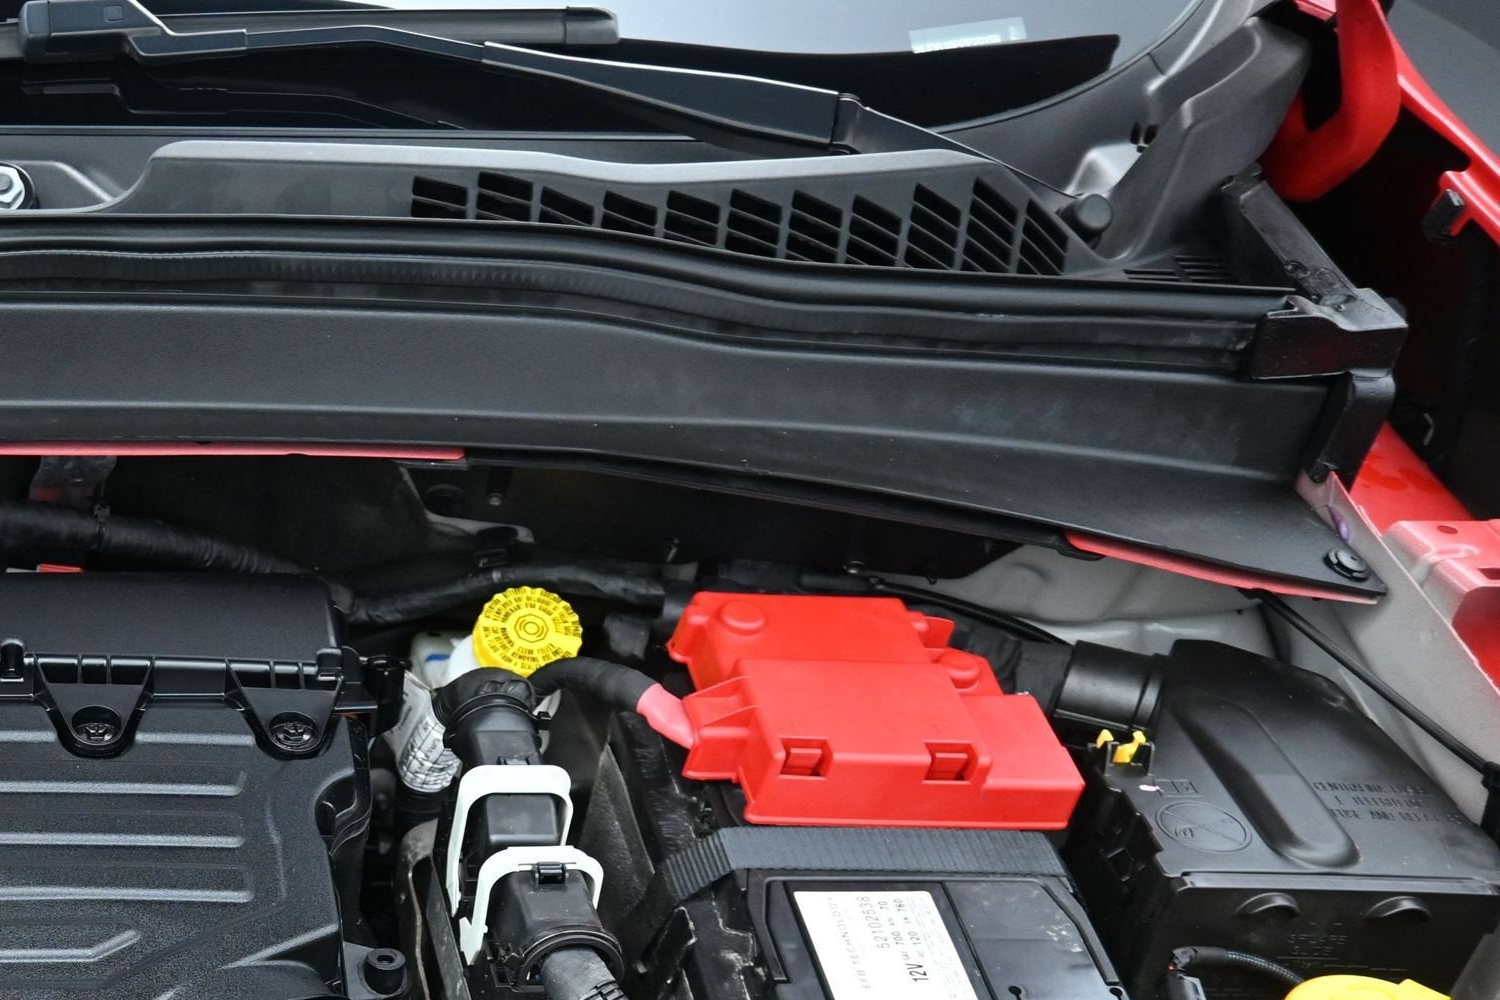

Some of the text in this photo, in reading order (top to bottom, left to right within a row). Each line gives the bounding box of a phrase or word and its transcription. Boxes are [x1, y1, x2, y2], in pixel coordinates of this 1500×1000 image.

[877, 900, 890, 909] 70
[892, 898, 907, 911] 760
[855, 895, 892, 949] 52102538
[890, 931, 905, 945] 700
[906, 931, 922, 945] 120
[904, 962, 931, 982] 12V
